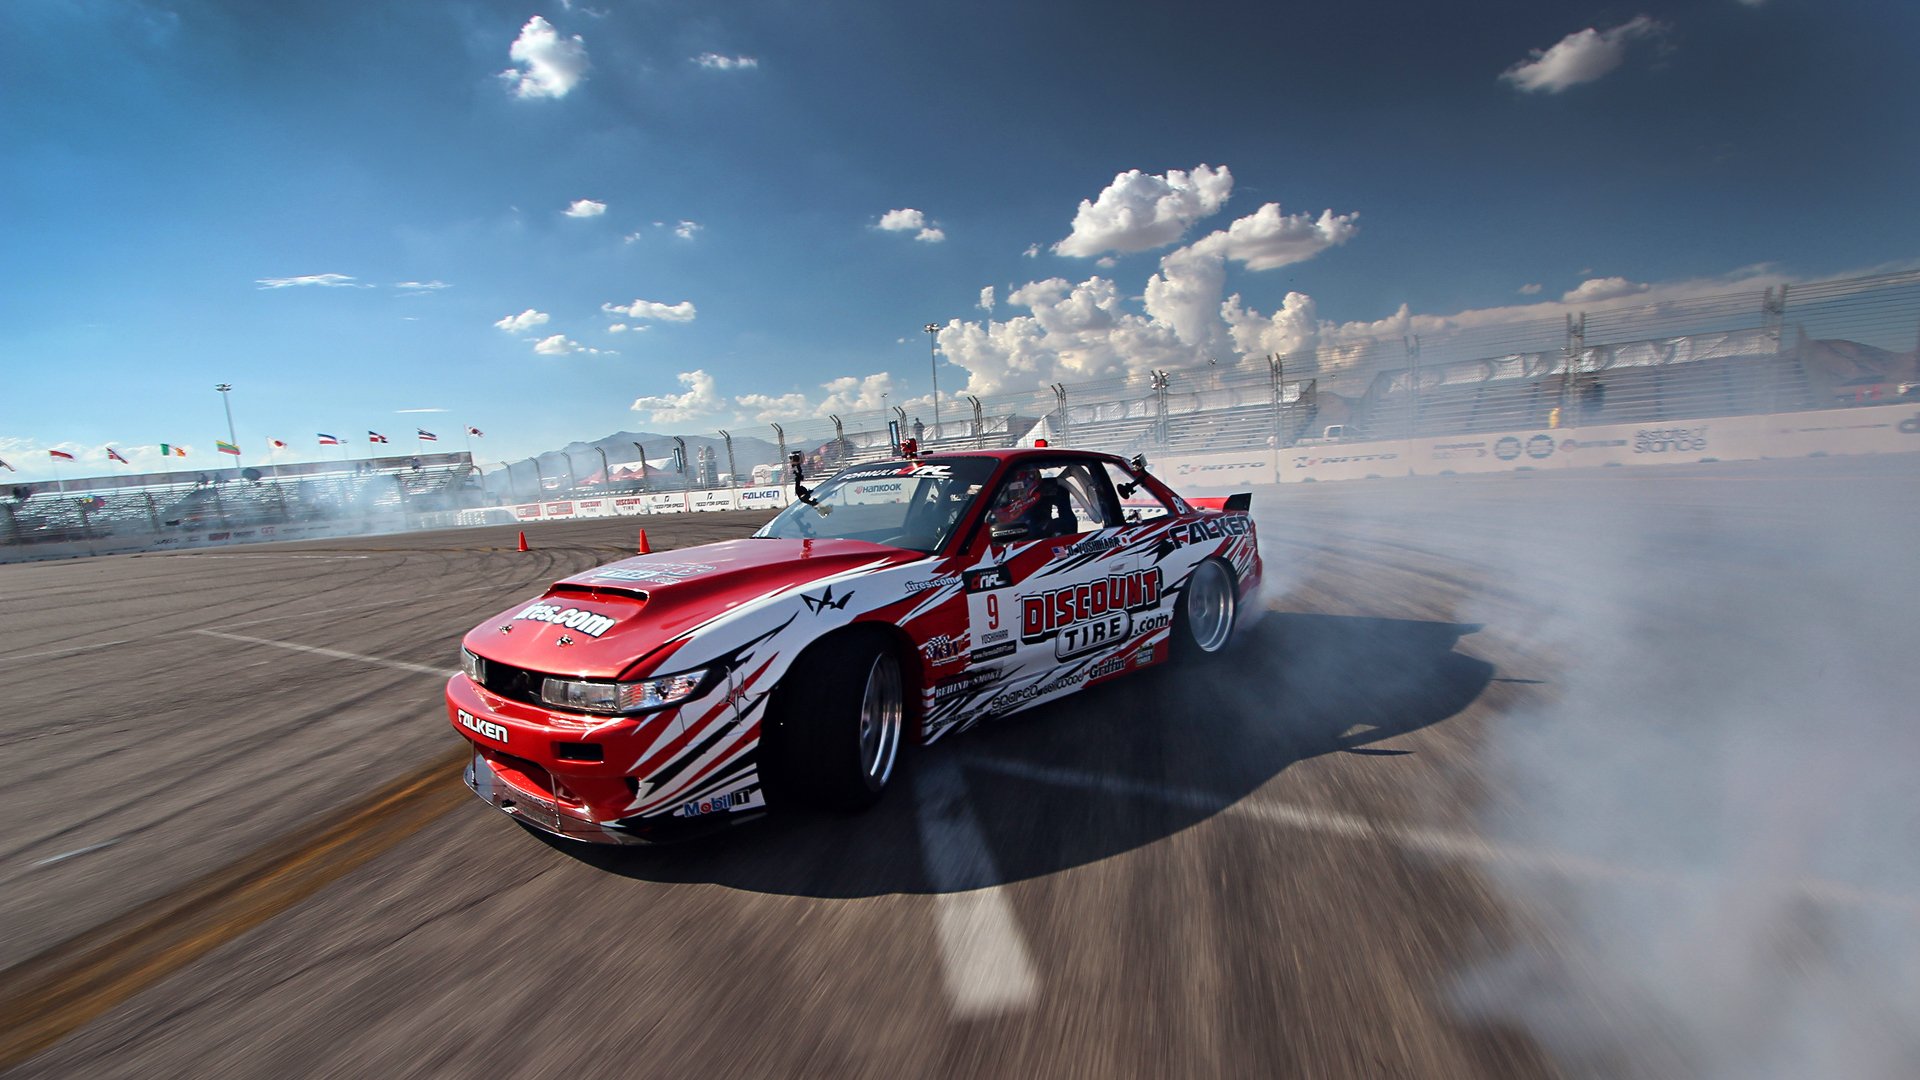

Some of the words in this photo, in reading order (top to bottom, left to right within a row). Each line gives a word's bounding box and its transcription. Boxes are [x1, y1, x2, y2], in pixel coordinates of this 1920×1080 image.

[742, 490, 780, 501] FALKEN
[1168, 515, 1252, 549] FALKEN
[987, 593, 999, 630] 9
[1022, 567, 1161, 642] DISCOUNT
[1064, 616, 1121, 651] TIRE
[1089, 657, 1126, 679] Griffin
[457, 707, 508, 743] FALKEN
[683, 793, 732, 818] Mobil
